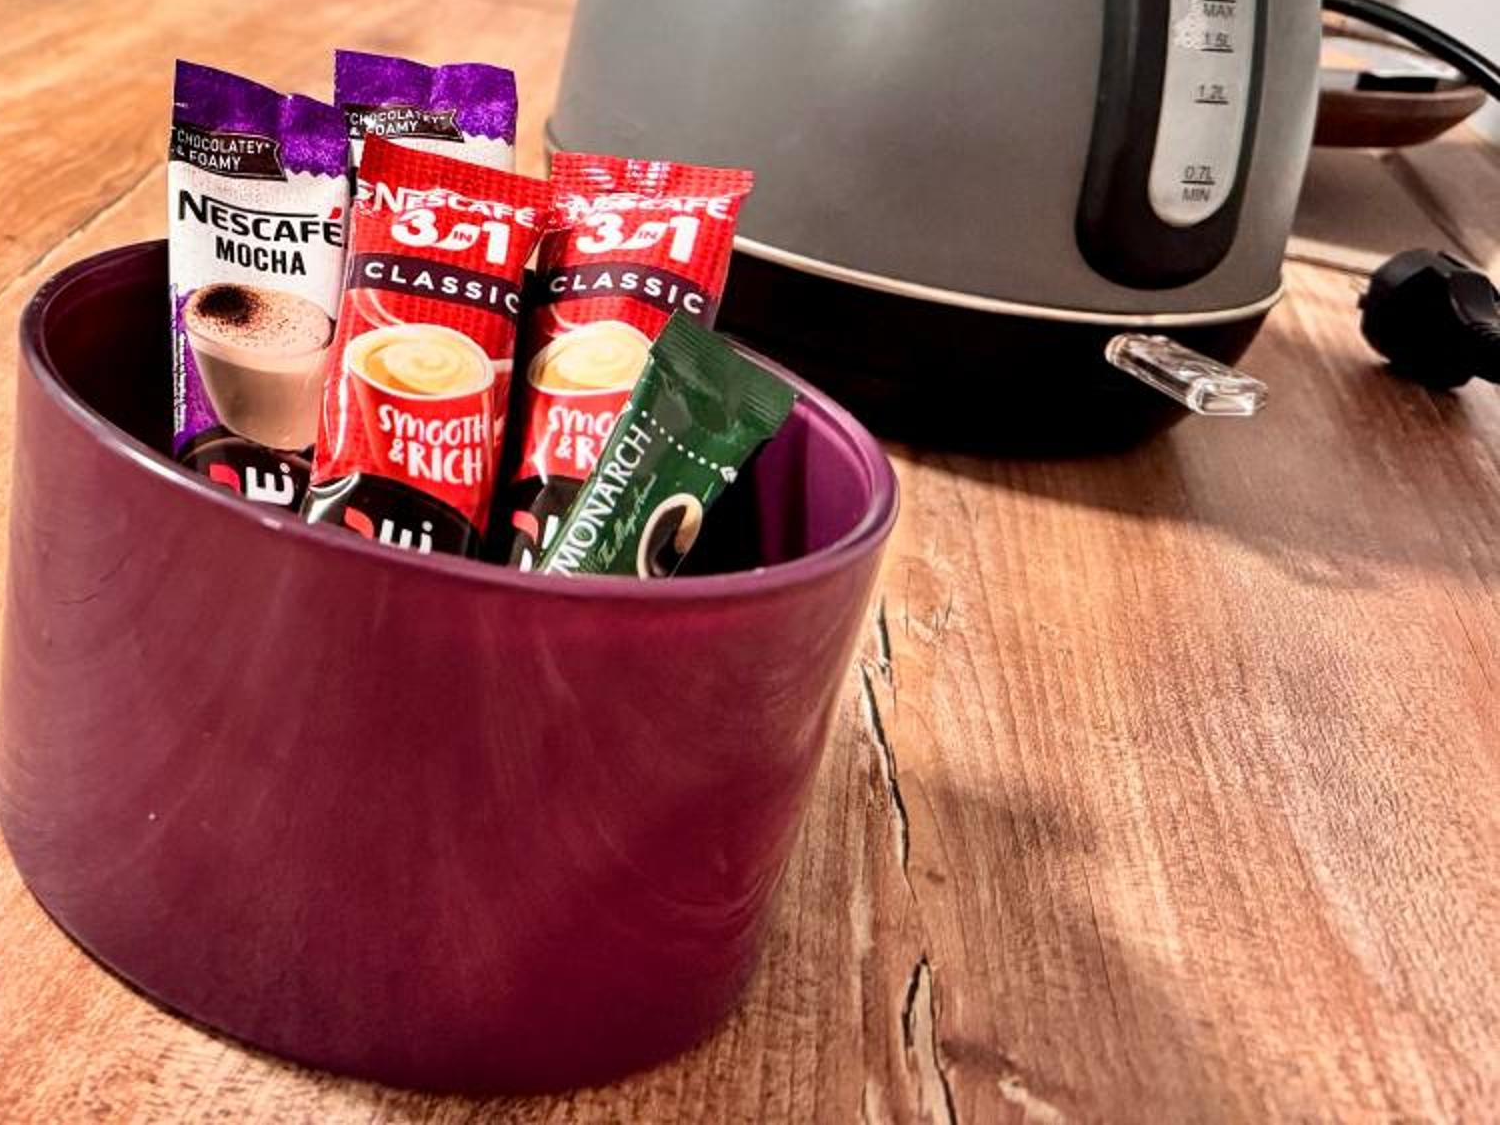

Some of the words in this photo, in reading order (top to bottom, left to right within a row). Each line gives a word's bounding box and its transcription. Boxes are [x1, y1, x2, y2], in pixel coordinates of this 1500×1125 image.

[1202, 2, 1235, 18] MAX
[189, 149, 242, 172] FOAMY
[1181, 187, 1211, 203] MIN
[178, 189, 344, 248] NESCAFÉ
[390, 208, 439, 247] 3
[453, 230, 474, 243] IN
[482, 221, 511, 266] 1
[576, 212, 624, 254] 3
[668, 216, 700, 264] 1
[215, 235, 307, 276] MOCHA
[364, 261, 520, 314] CLASSIC
[550, 271, 705, 314] CLASSIC
[387, 438, 405, 466] &
[407, 441, 484, 488] RICH
[555, 435, 573, 460] &
[543, 423, 652, 577] MONARCH
